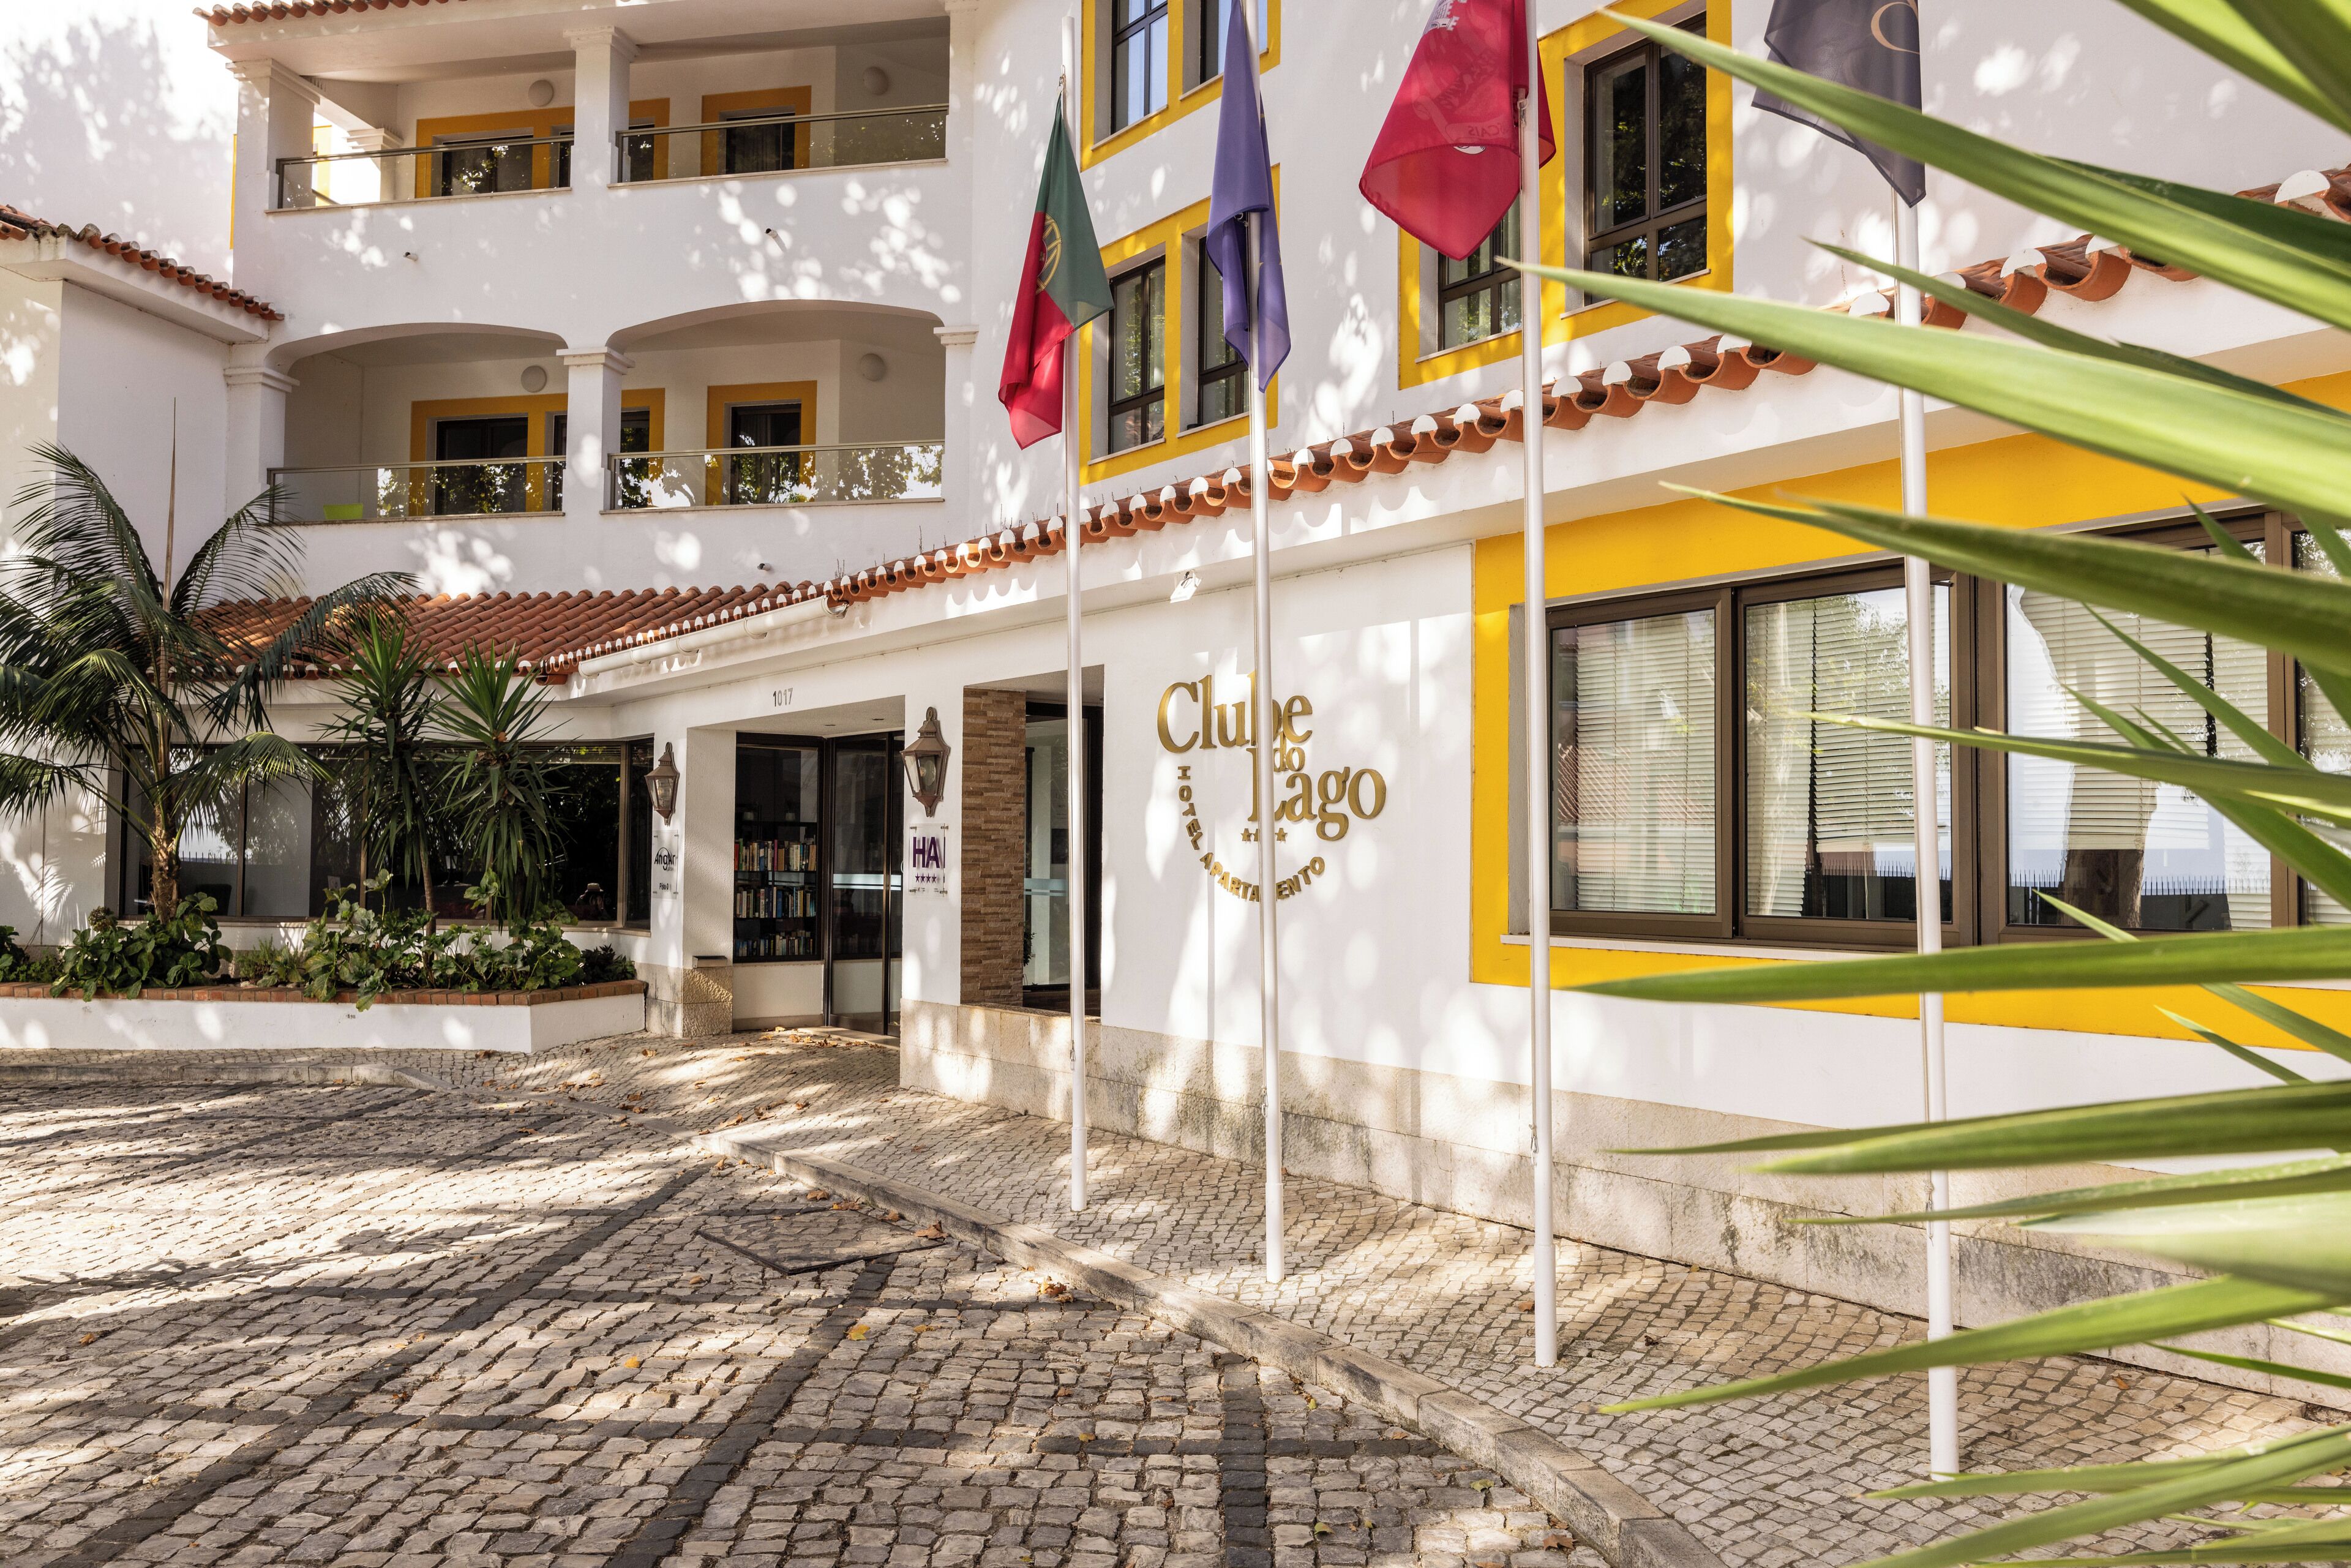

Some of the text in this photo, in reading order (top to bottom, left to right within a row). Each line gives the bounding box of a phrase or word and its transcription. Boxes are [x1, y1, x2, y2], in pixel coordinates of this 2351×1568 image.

[773, 688, 793, 707] 1017
[1157, 670, 1313, 754] Clube
[1273, 730, 1305, 772] do
[1177, 766, 1325, 902] HOTEL APARTAENTO
[1246, 748, 1386, 841] Lago
